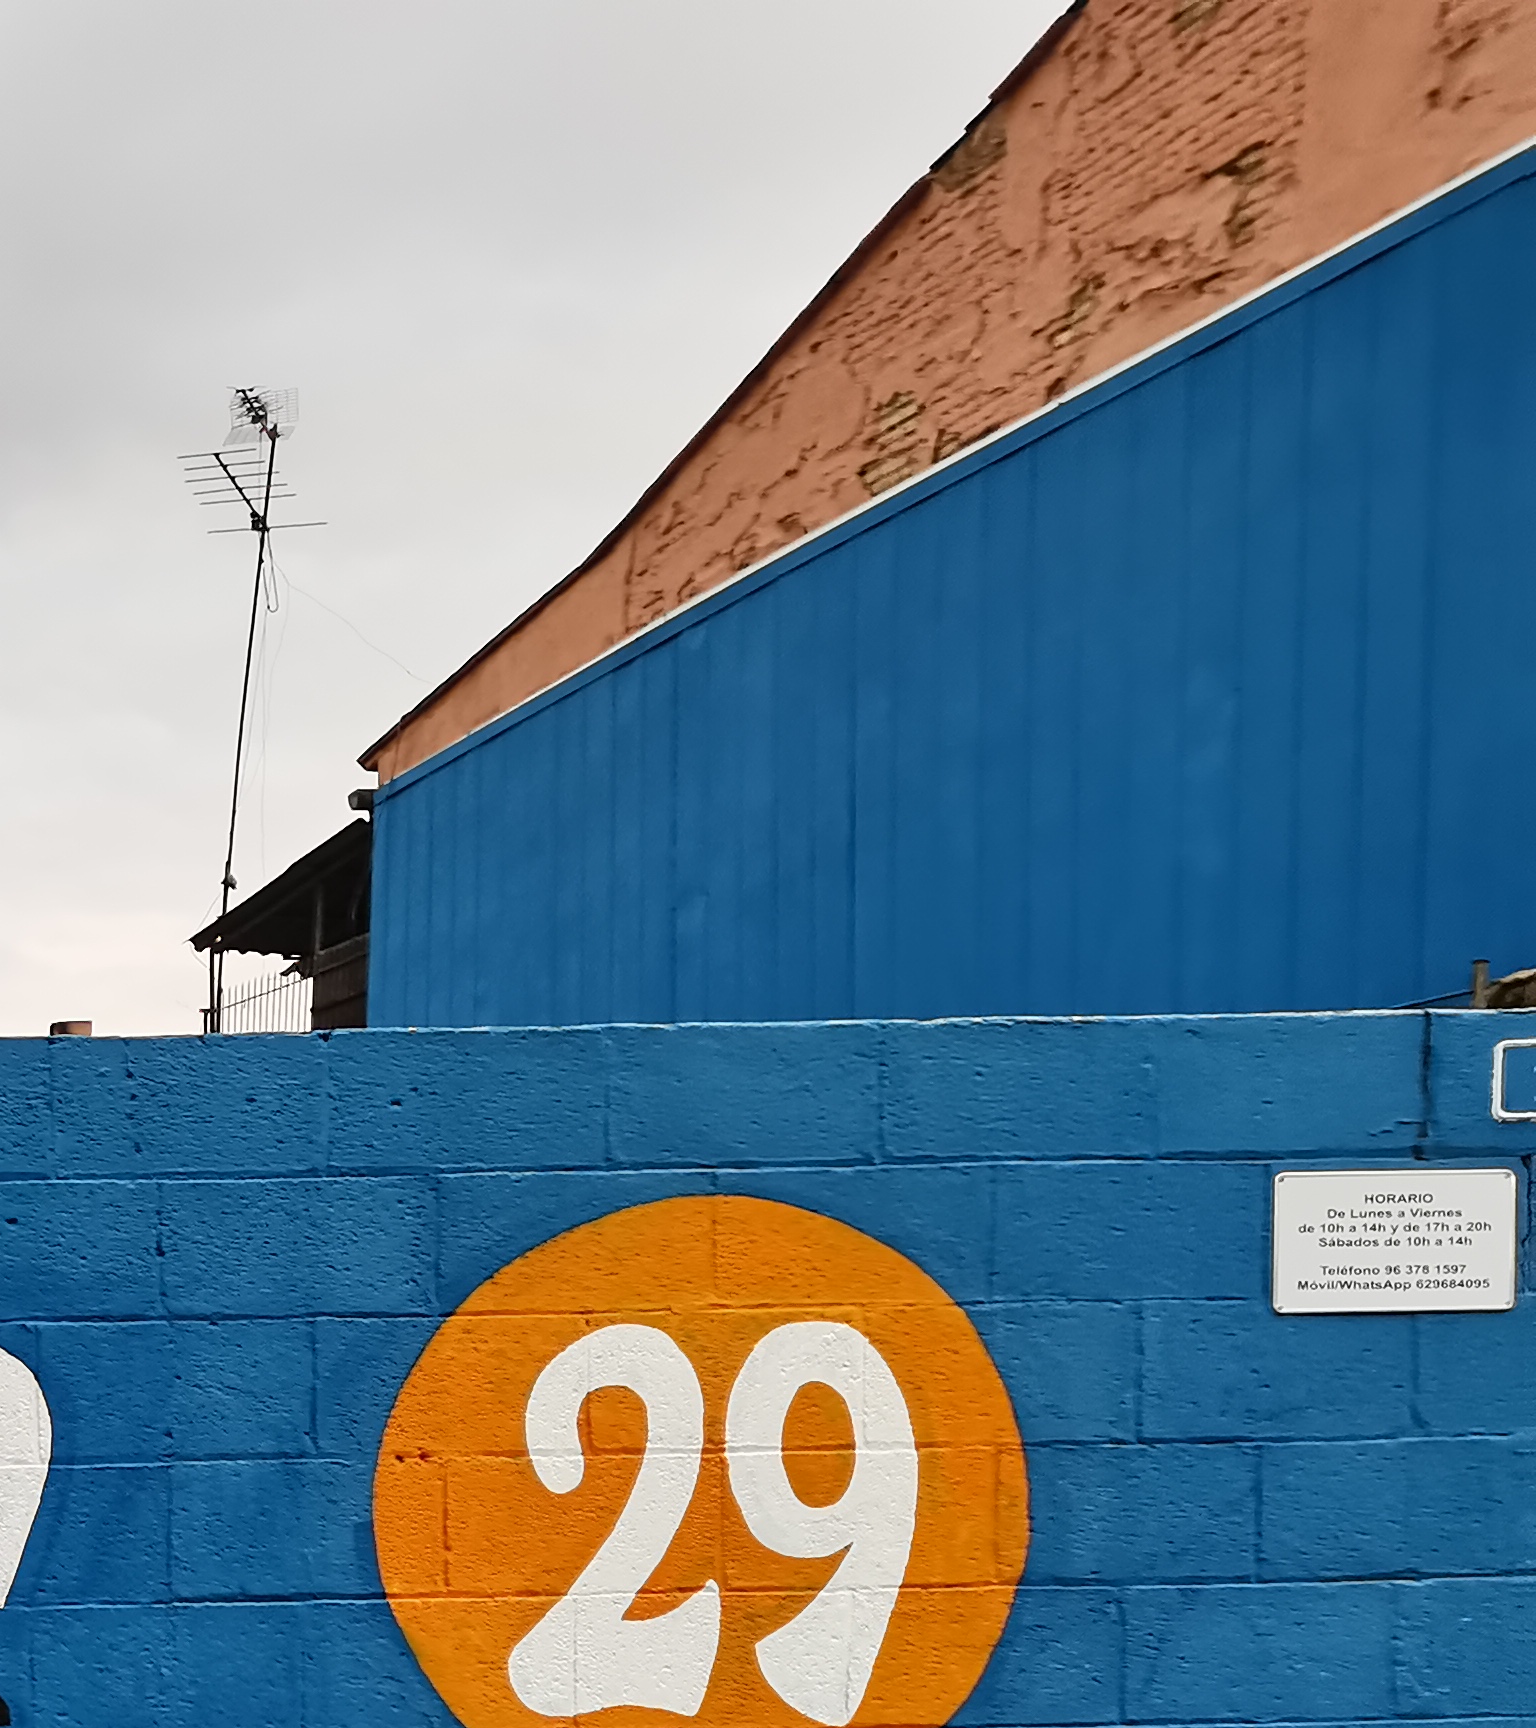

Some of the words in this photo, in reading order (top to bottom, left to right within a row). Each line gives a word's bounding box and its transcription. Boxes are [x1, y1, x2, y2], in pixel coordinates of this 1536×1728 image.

[1364, 1193, 1434, 1204] HORARIO
[1326, 1208, 1346, 1219] De
[1350, 1208, 1393, 1218] Lunes
[1396, 1210, 1406, 1218] a
[1409, 1207, 1463, 1218] Viernes
[1297, 1223, 1316, 1233] de
[1319, 1222, 1345, 1233] 10h
[1361, 1222, 1387, 1233] 14h
[1390, 1224, 1400, 1235] y
[1402, 1221, 1421, 1232] de
[1424, 1221, 1450, 1232] 17h
[1453, 1223, 1462, 1231] a
[1465, 1221, 1492, 1231] 20h
[1318, 1236, 1380, 1247] Sábados
[1383, 1236, 1401, 1246] de
[1406, 1236, 1431, 1246] 10h
[1434, 1238, 1443, 1246] a
[1447, 1235, 1473, 1245] 14h
[1319, 1265, 1381, 1275] Teléfono
[1384, 1264, 1402, 1275] 96
[1405, 1264, 1430, 1275] 378
[1434, 1263, 1467, 1274] 1597
[1297, 1279, 1412, 1291] Móvil/WhatsApp
[508, 1321, 918, 1727] 29
